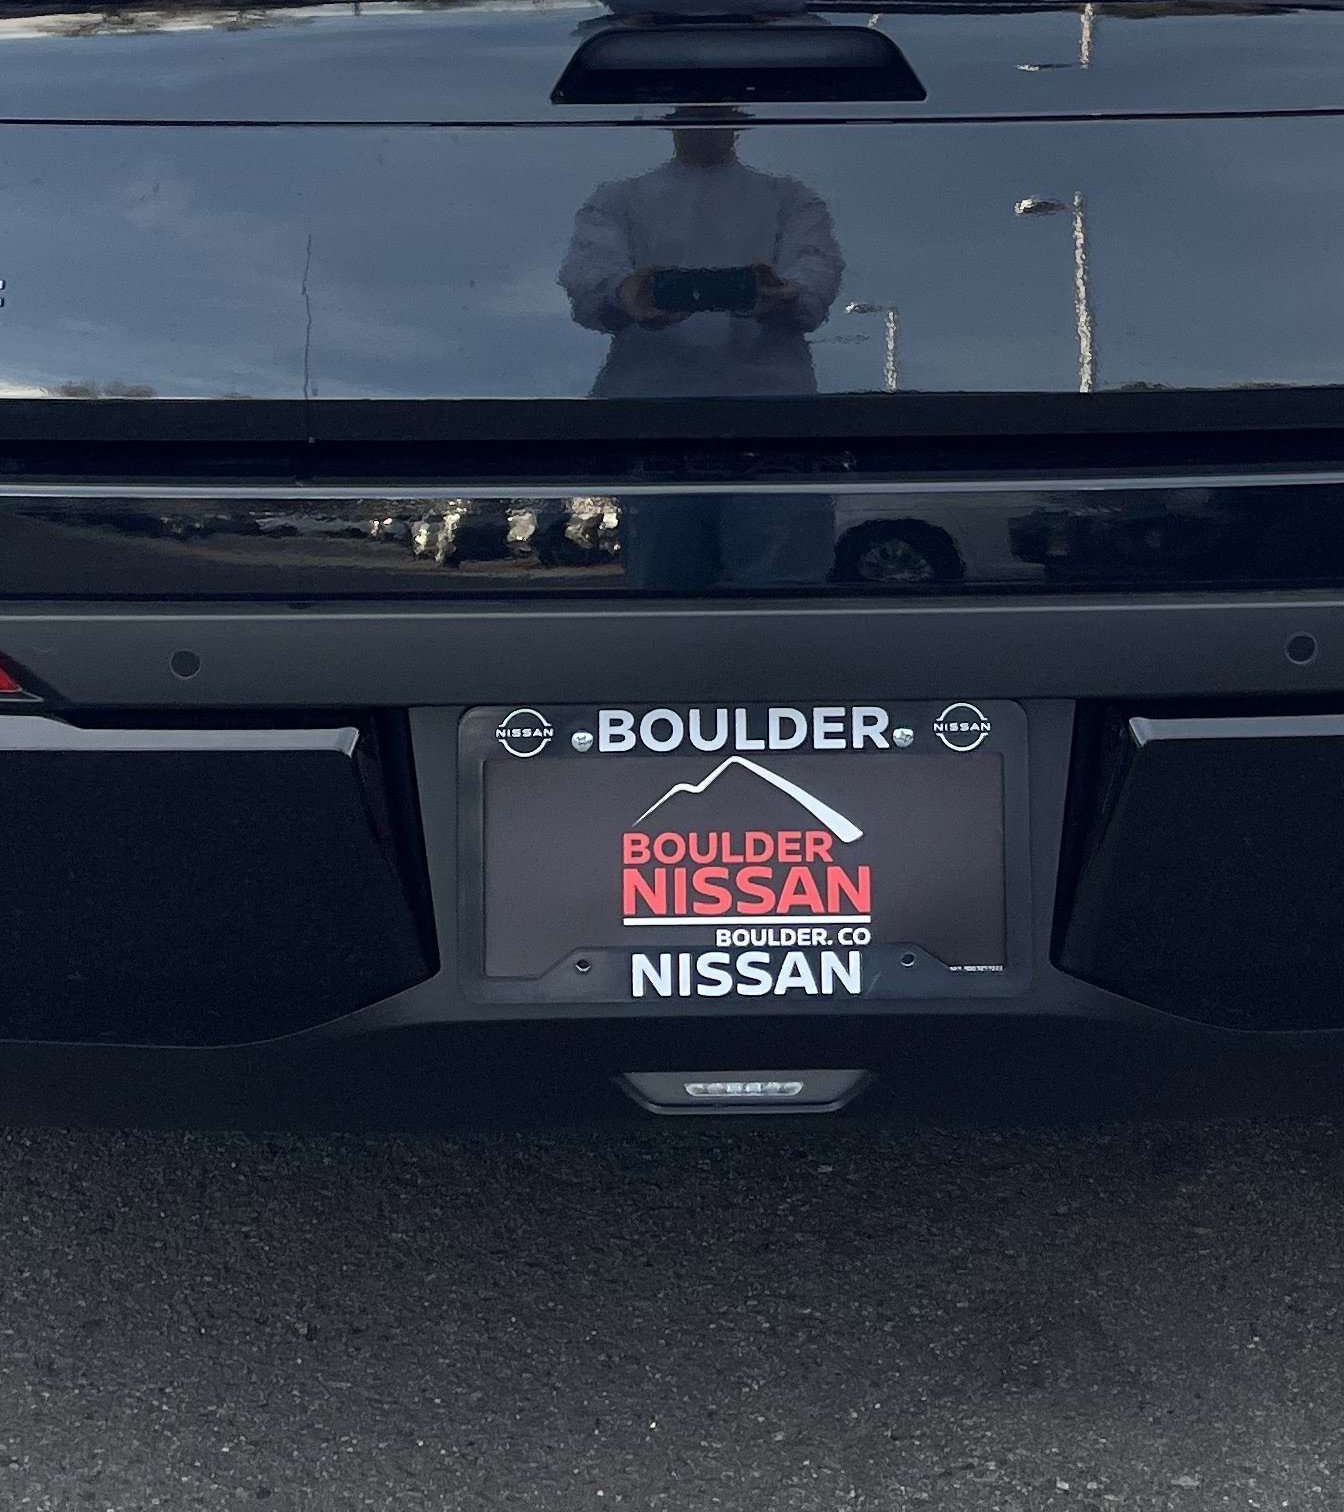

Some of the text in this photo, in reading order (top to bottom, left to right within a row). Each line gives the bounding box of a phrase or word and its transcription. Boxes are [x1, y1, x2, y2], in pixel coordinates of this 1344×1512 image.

[496, 728, 554, 738] NISSAN
[598, 706, 890, 752] BOULDER
[933, 722, 991, 732] NISSAN
[622, 831, 834, 864] BOULDER
[622, 865, 872, 916] NISSAN
[837, 927, 872, 947] CO
[631, 950, 862, 997] NISSAN
